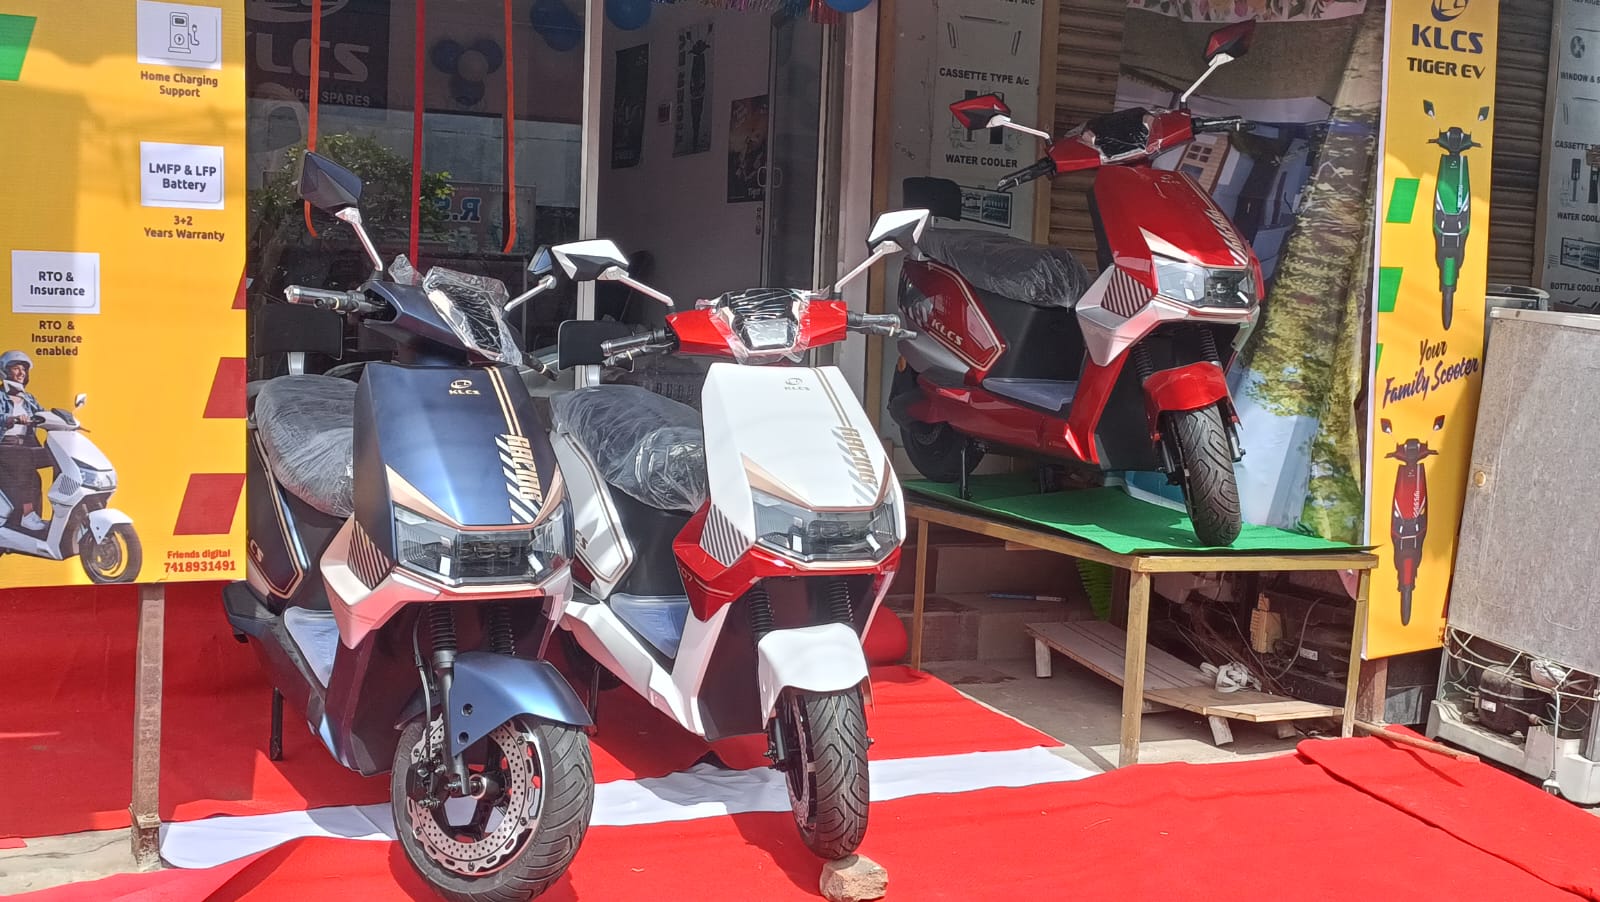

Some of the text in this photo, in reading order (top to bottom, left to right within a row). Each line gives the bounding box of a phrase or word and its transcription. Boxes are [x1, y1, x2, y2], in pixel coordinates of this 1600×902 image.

[1411, 23, 1484, 54] KLCS
[246, 31, 370, 82] LCS
[1406, 56, 1486, 79] TIGER EV
[140, 70, 218, 88] Home Charging
[939, 67, 1030, 86] CASSETTE TYPE A/c
[1560, 71, 1588, 82] WINDOW
[159, 84, 201, 98] Support
[321, 90, 371, 107] SPARES
[945, 153, 1018, 169] WATER COOLER
[148, 162, 217, 177] LMFP & LFP
[162, 178, 206, 193] Battery
[173, 215, 193, 226] 3+2
[1557, 212, 1580, 222] WATER
[143, 227, 225, 242] Years Warranty
[38, 271, 75, 282] RTO &
[30, 284, 86, 296] Insurance
[1550, 282, 1576, 291] BOTTLE
[39, 320, 75, 330] RTO &
[931, 319, 963, 346] KLCS
[31, 333, 83, 343] Insurance
[35, 346, 79, 356] enabled
[1418, 338, 1447, 366] Your
[1382, 356, 1479, 410] Family Scooter
[836, 426, 879, 489] RACING
[503, 434, 543, 507] RACING
[167, 549, 231, 559] Friends digital
[164, 560, 236, 573] 7418931491
